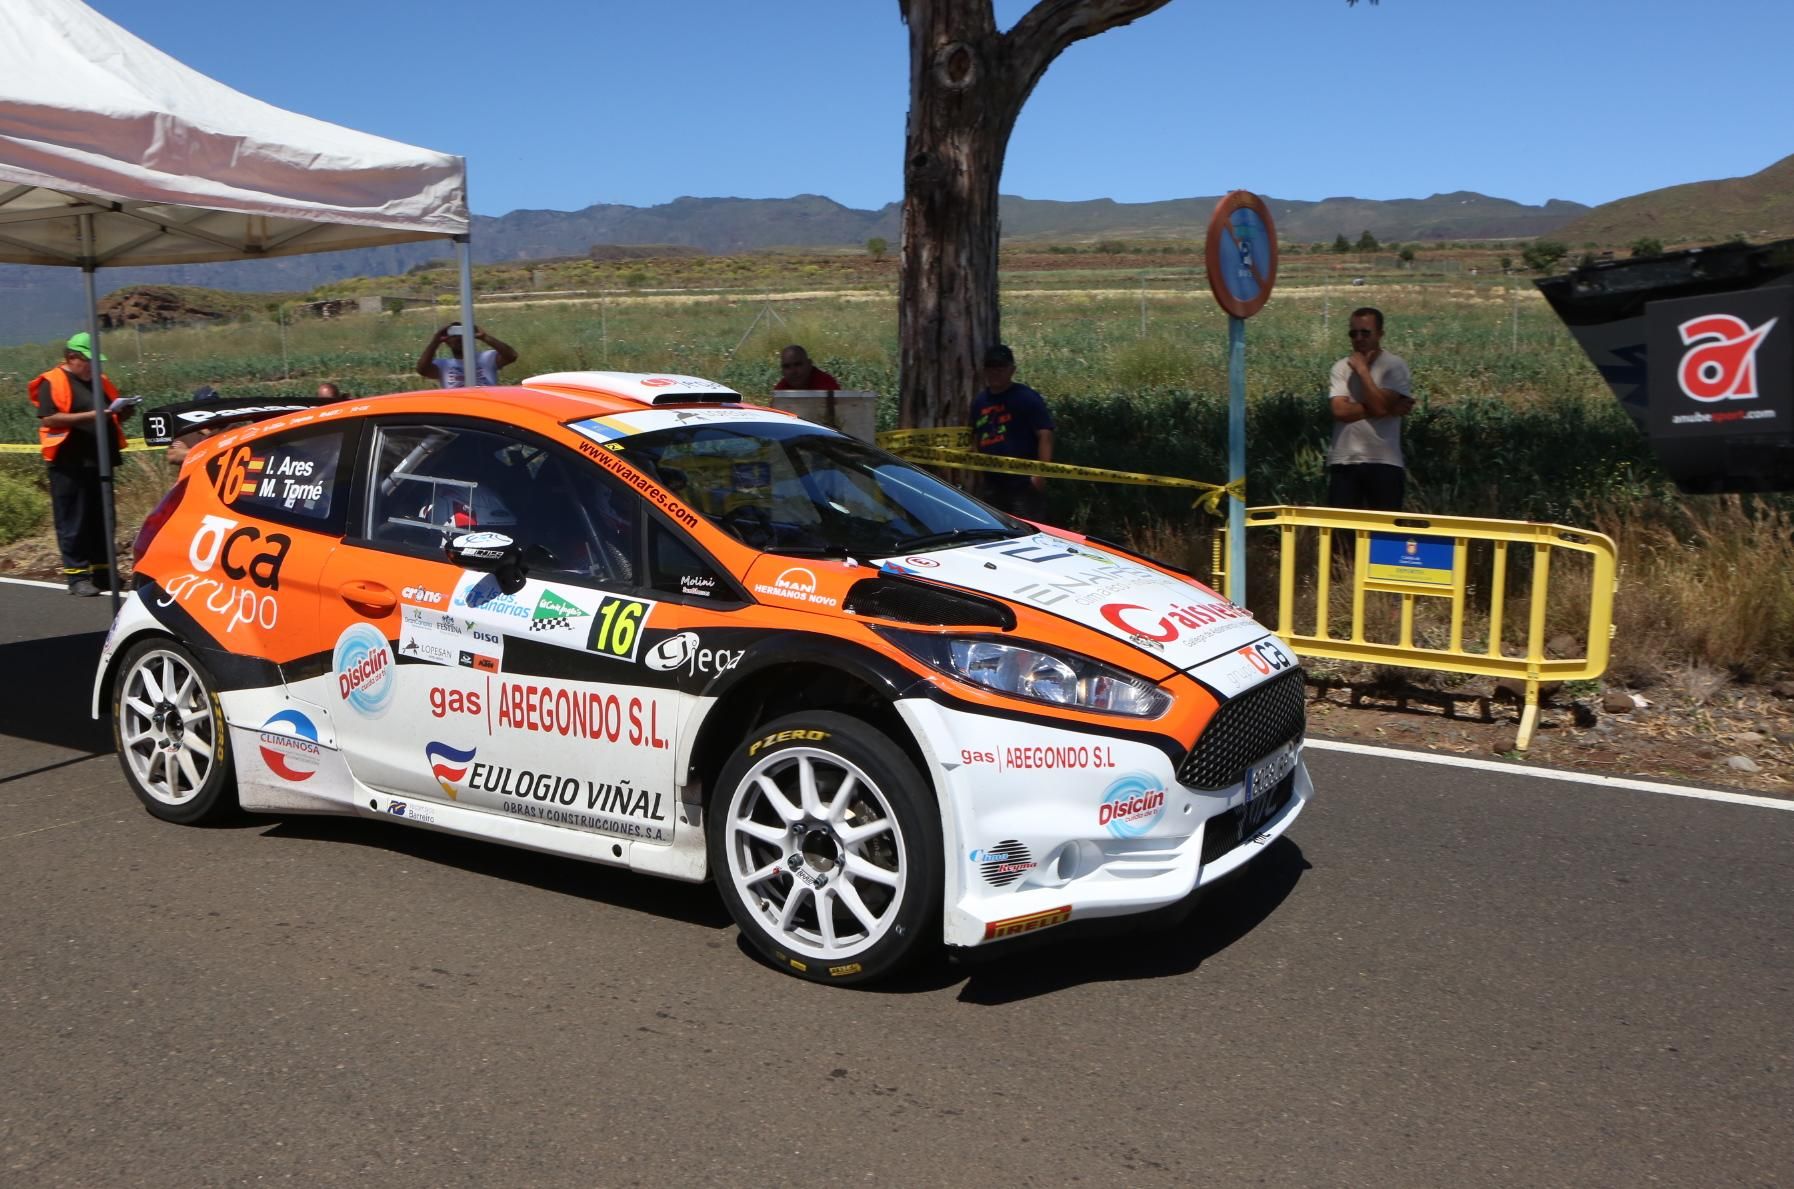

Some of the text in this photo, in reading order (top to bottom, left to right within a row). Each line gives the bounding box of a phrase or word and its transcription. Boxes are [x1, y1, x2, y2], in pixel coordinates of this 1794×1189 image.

[217, 446, 251, 504] 16
[266, 456, 314, 476] I. Ares
[259, 479, 323, 500] M. Tomé
[579, 441, 698, 528] www.ivanares.com
[680, 575, 715, 587] Molini
[156, 574, 277, 632] grupo
[755, 584, 837, 606] HERMANOS NOVO
[436, 622, 462, 634] FESTINA
[597, 600, 644, 655] 16
[421, 645, 452, 659] LOPESAN
[339, 649, 387, 700] Disiclin
[430, 682, 670, 750] gas ABEGONDO S.L.
[260, 733, 320, 755] CLIMANOSA
[961, 749, 995, 765] gas
[1006, 747, 1089, 769] ABEGONDO
[468, 763, 667, 821] EULOGIO VIÑAL
[408, 810, 435, 823] Barreiro
[503, 801, 537, 817] OBRAS
[538, 807, 545, 819] Y
[1099, 788, 1164, 825] Disiclin
